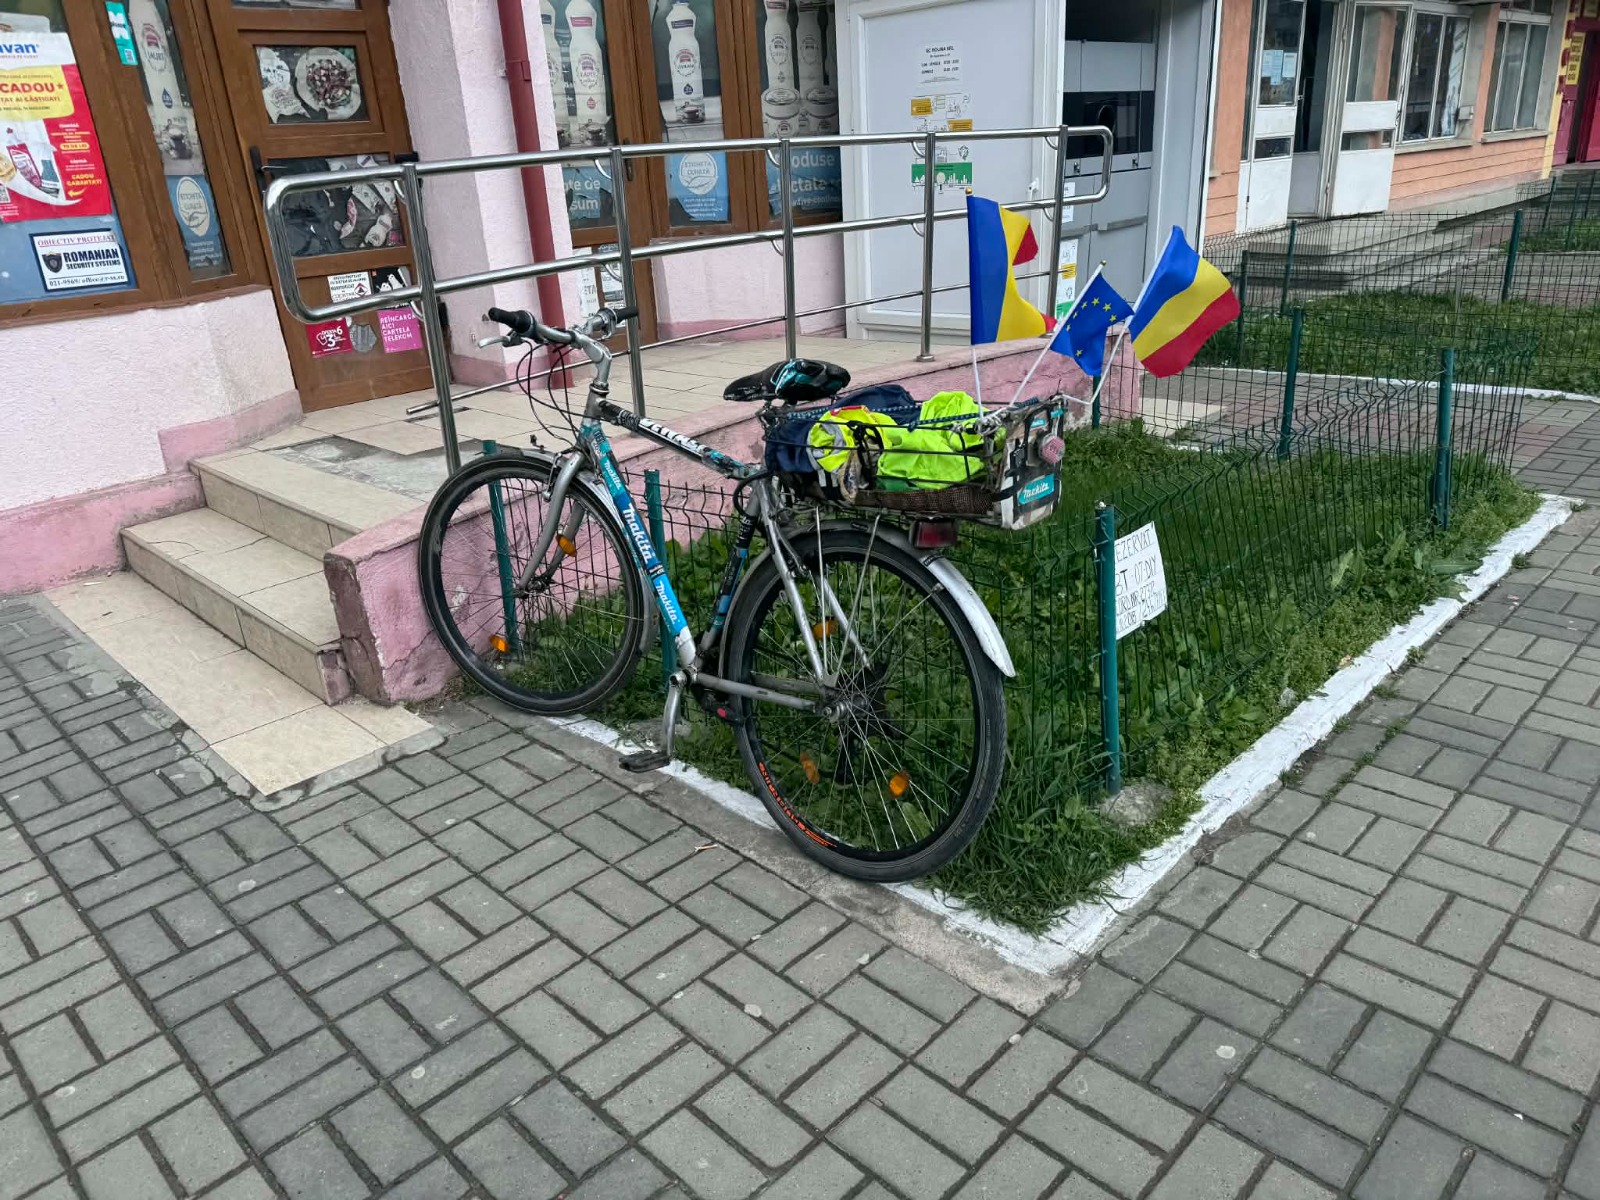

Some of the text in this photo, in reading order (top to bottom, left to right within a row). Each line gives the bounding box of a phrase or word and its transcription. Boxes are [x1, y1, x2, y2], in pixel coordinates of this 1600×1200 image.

[0, 82, 55, 93] CADOU
[38, 237, 75, 246] OBIECTIV
[63, 248, 119, 263] ROMANIAN
[66, 259, 121, 270] SECURITY SYSTEMS
[336, 325, 343, 335] 6
[382, 327, 410, 336] CARTELA
[326, 334, 336, 347] 3
[384, 333, 413, 342] TELEKOM
